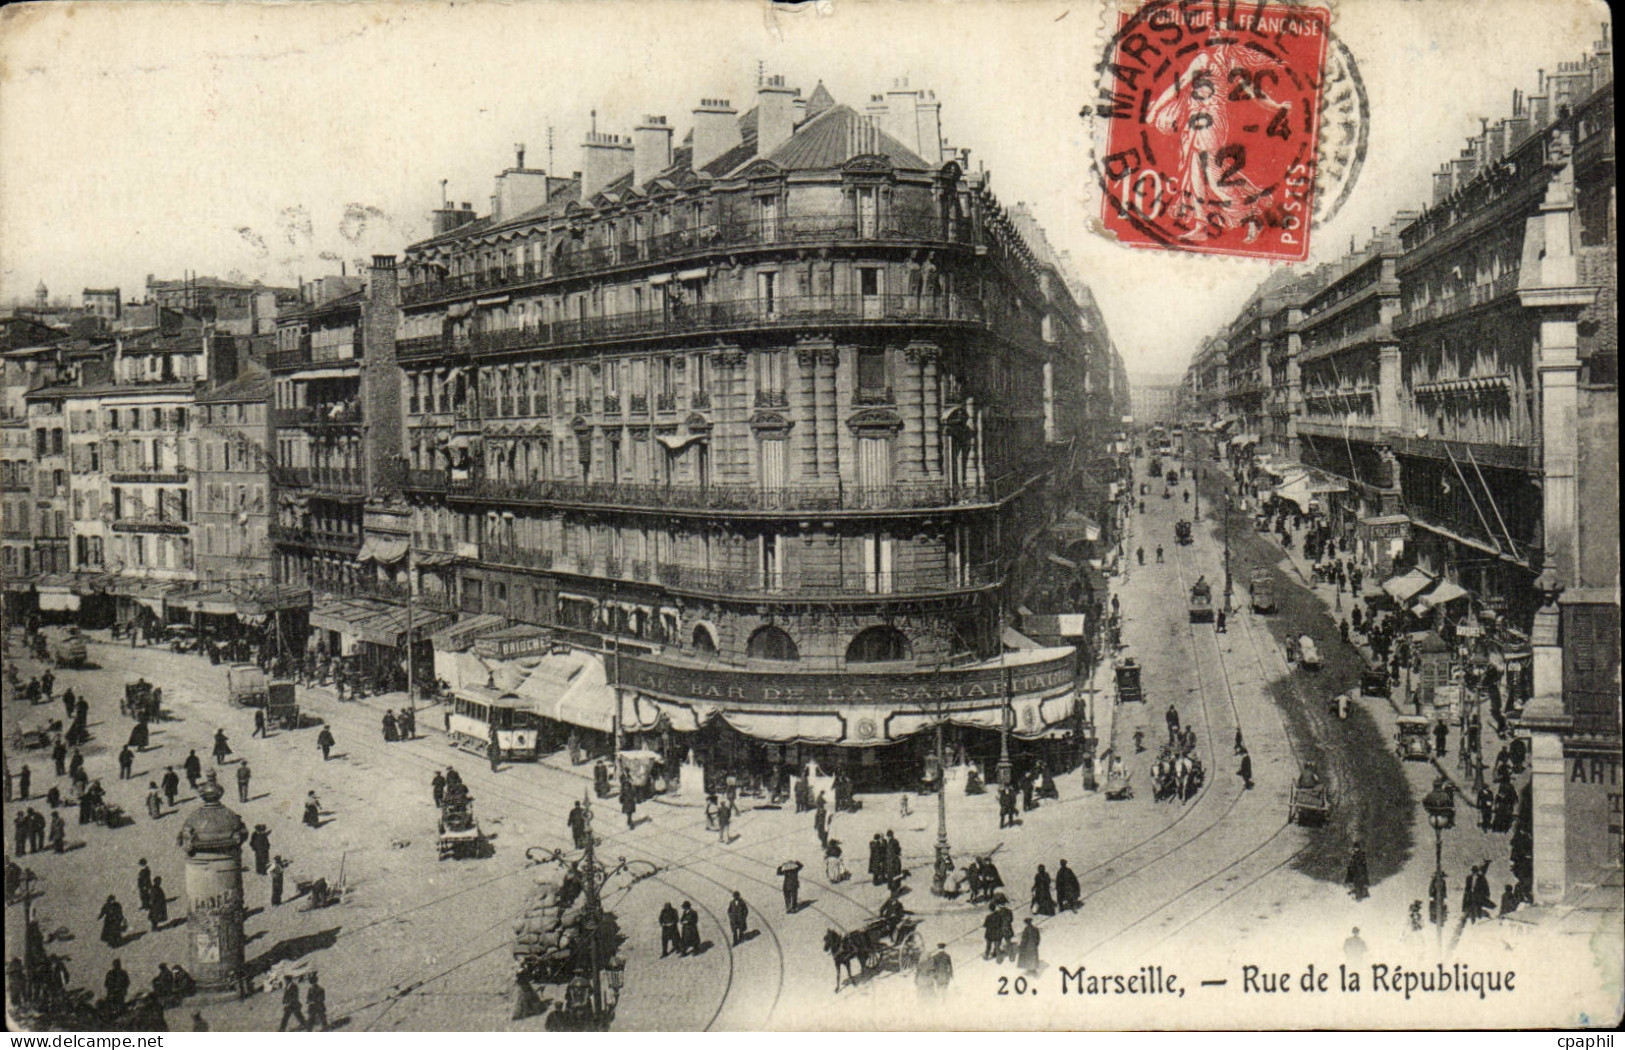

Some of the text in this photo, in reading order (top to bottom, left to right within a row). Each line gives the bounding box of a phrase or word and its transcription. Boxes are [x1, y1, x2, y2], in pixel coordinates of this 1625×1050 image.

[691, 683, 745, 699] BAR
[764, 687, 804, 700] DE
[827, 687, 869, 700] LA
